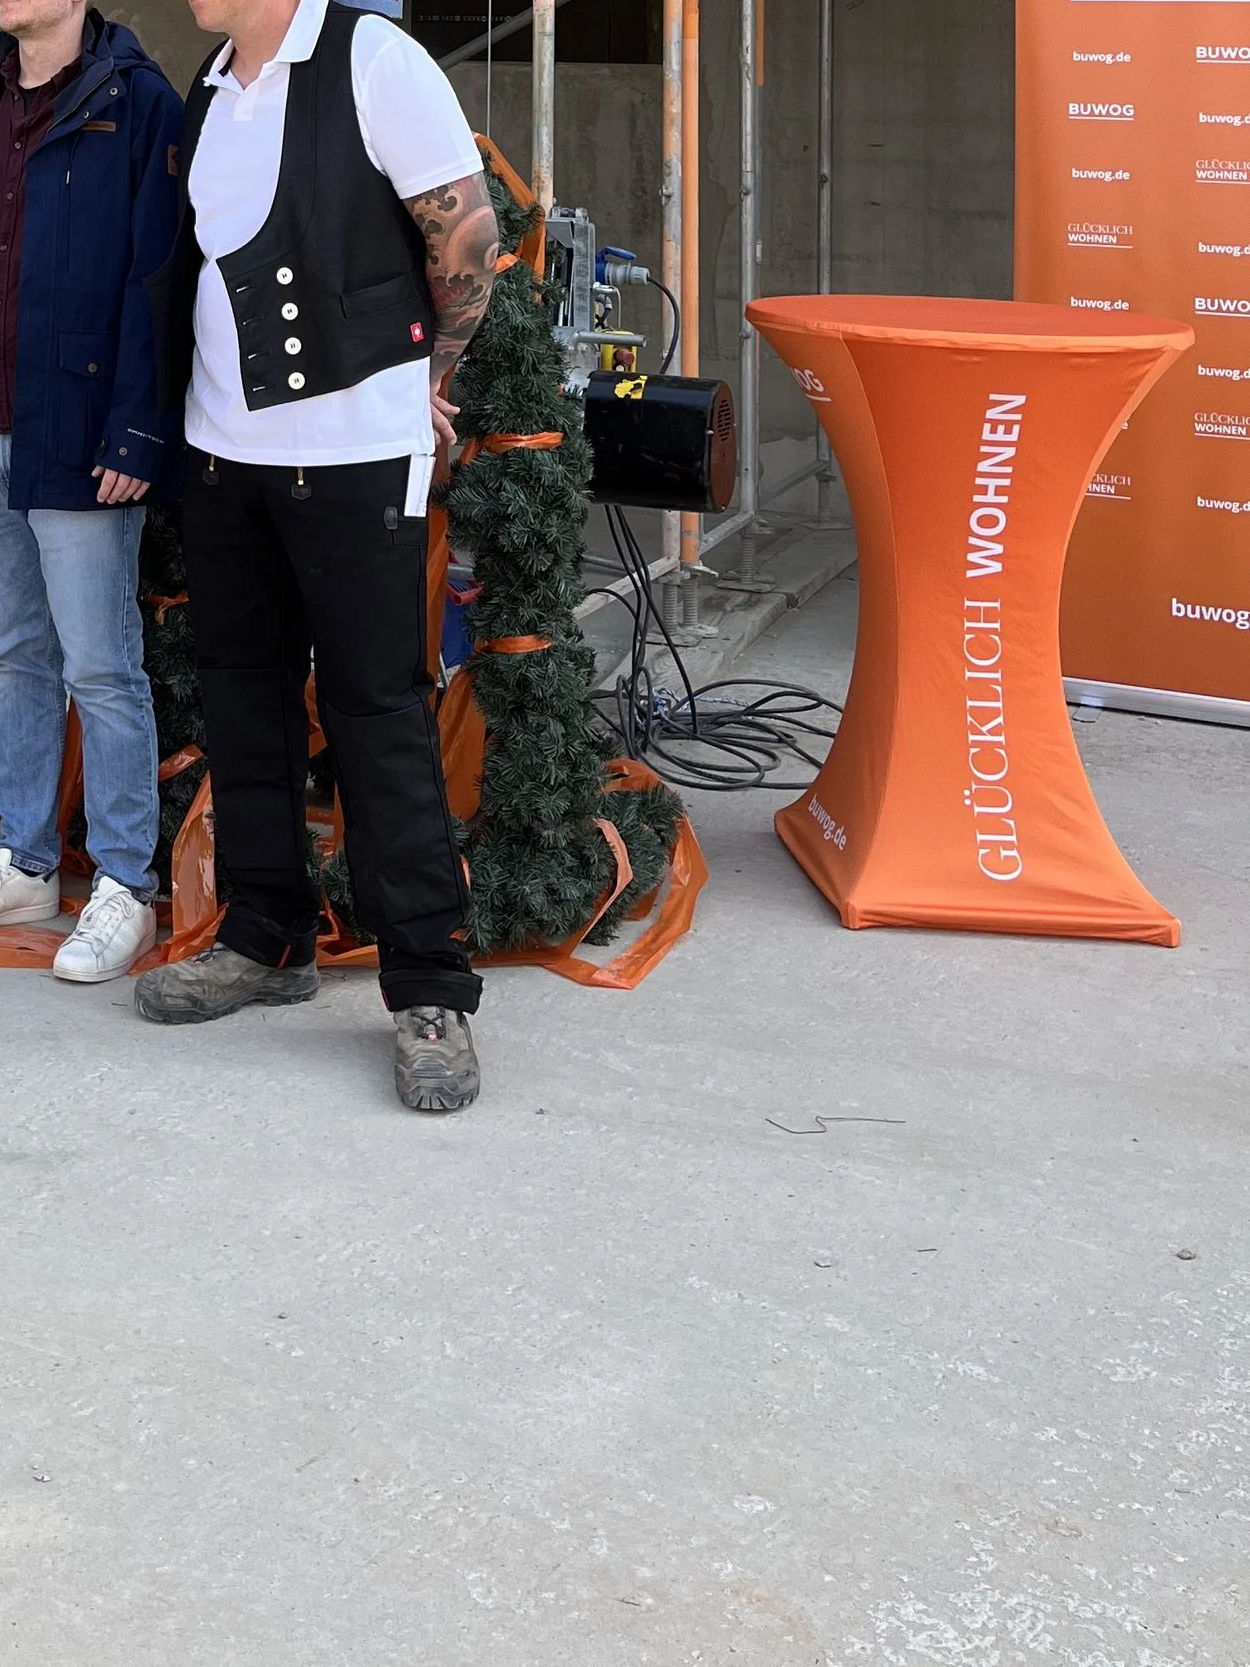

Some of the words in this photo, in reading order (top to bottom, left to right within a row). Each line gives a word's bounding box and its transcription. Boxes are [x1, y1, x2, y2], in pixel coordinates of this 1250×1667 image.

[1072, 51, 1131, 64] buwog.de
[1196, 46, 1250, 59] BUWO
[1068, 103, 1134, 116] BUWOG
[1199, 112, 1250, 127] buwog.d
[1071, 167, 1131, 181] buwog.de
[1195, 169, 1247, 180] WOHNEN
[1067, 222, 1133, 235] GLÜCKLICH
[1068, 233, 1117, 244] WOHNEN
[1198, 241, 1250, 257] buwog.d
[1070, 296, 1129, 310] buwog.de
[1194, 297, 1250, 313] BUWO
[1197, 364, 1250, 381] buwog.d
[1194, 423, 1247, 436] WOHNEN
[966, 393, 1027, 579] WOHNEN
[1197, 496, 1250, 513] buwog.d
[963, 597, 1022, 881] GLÜCKLICH
[808, 793, 847, 851] buwog.de
